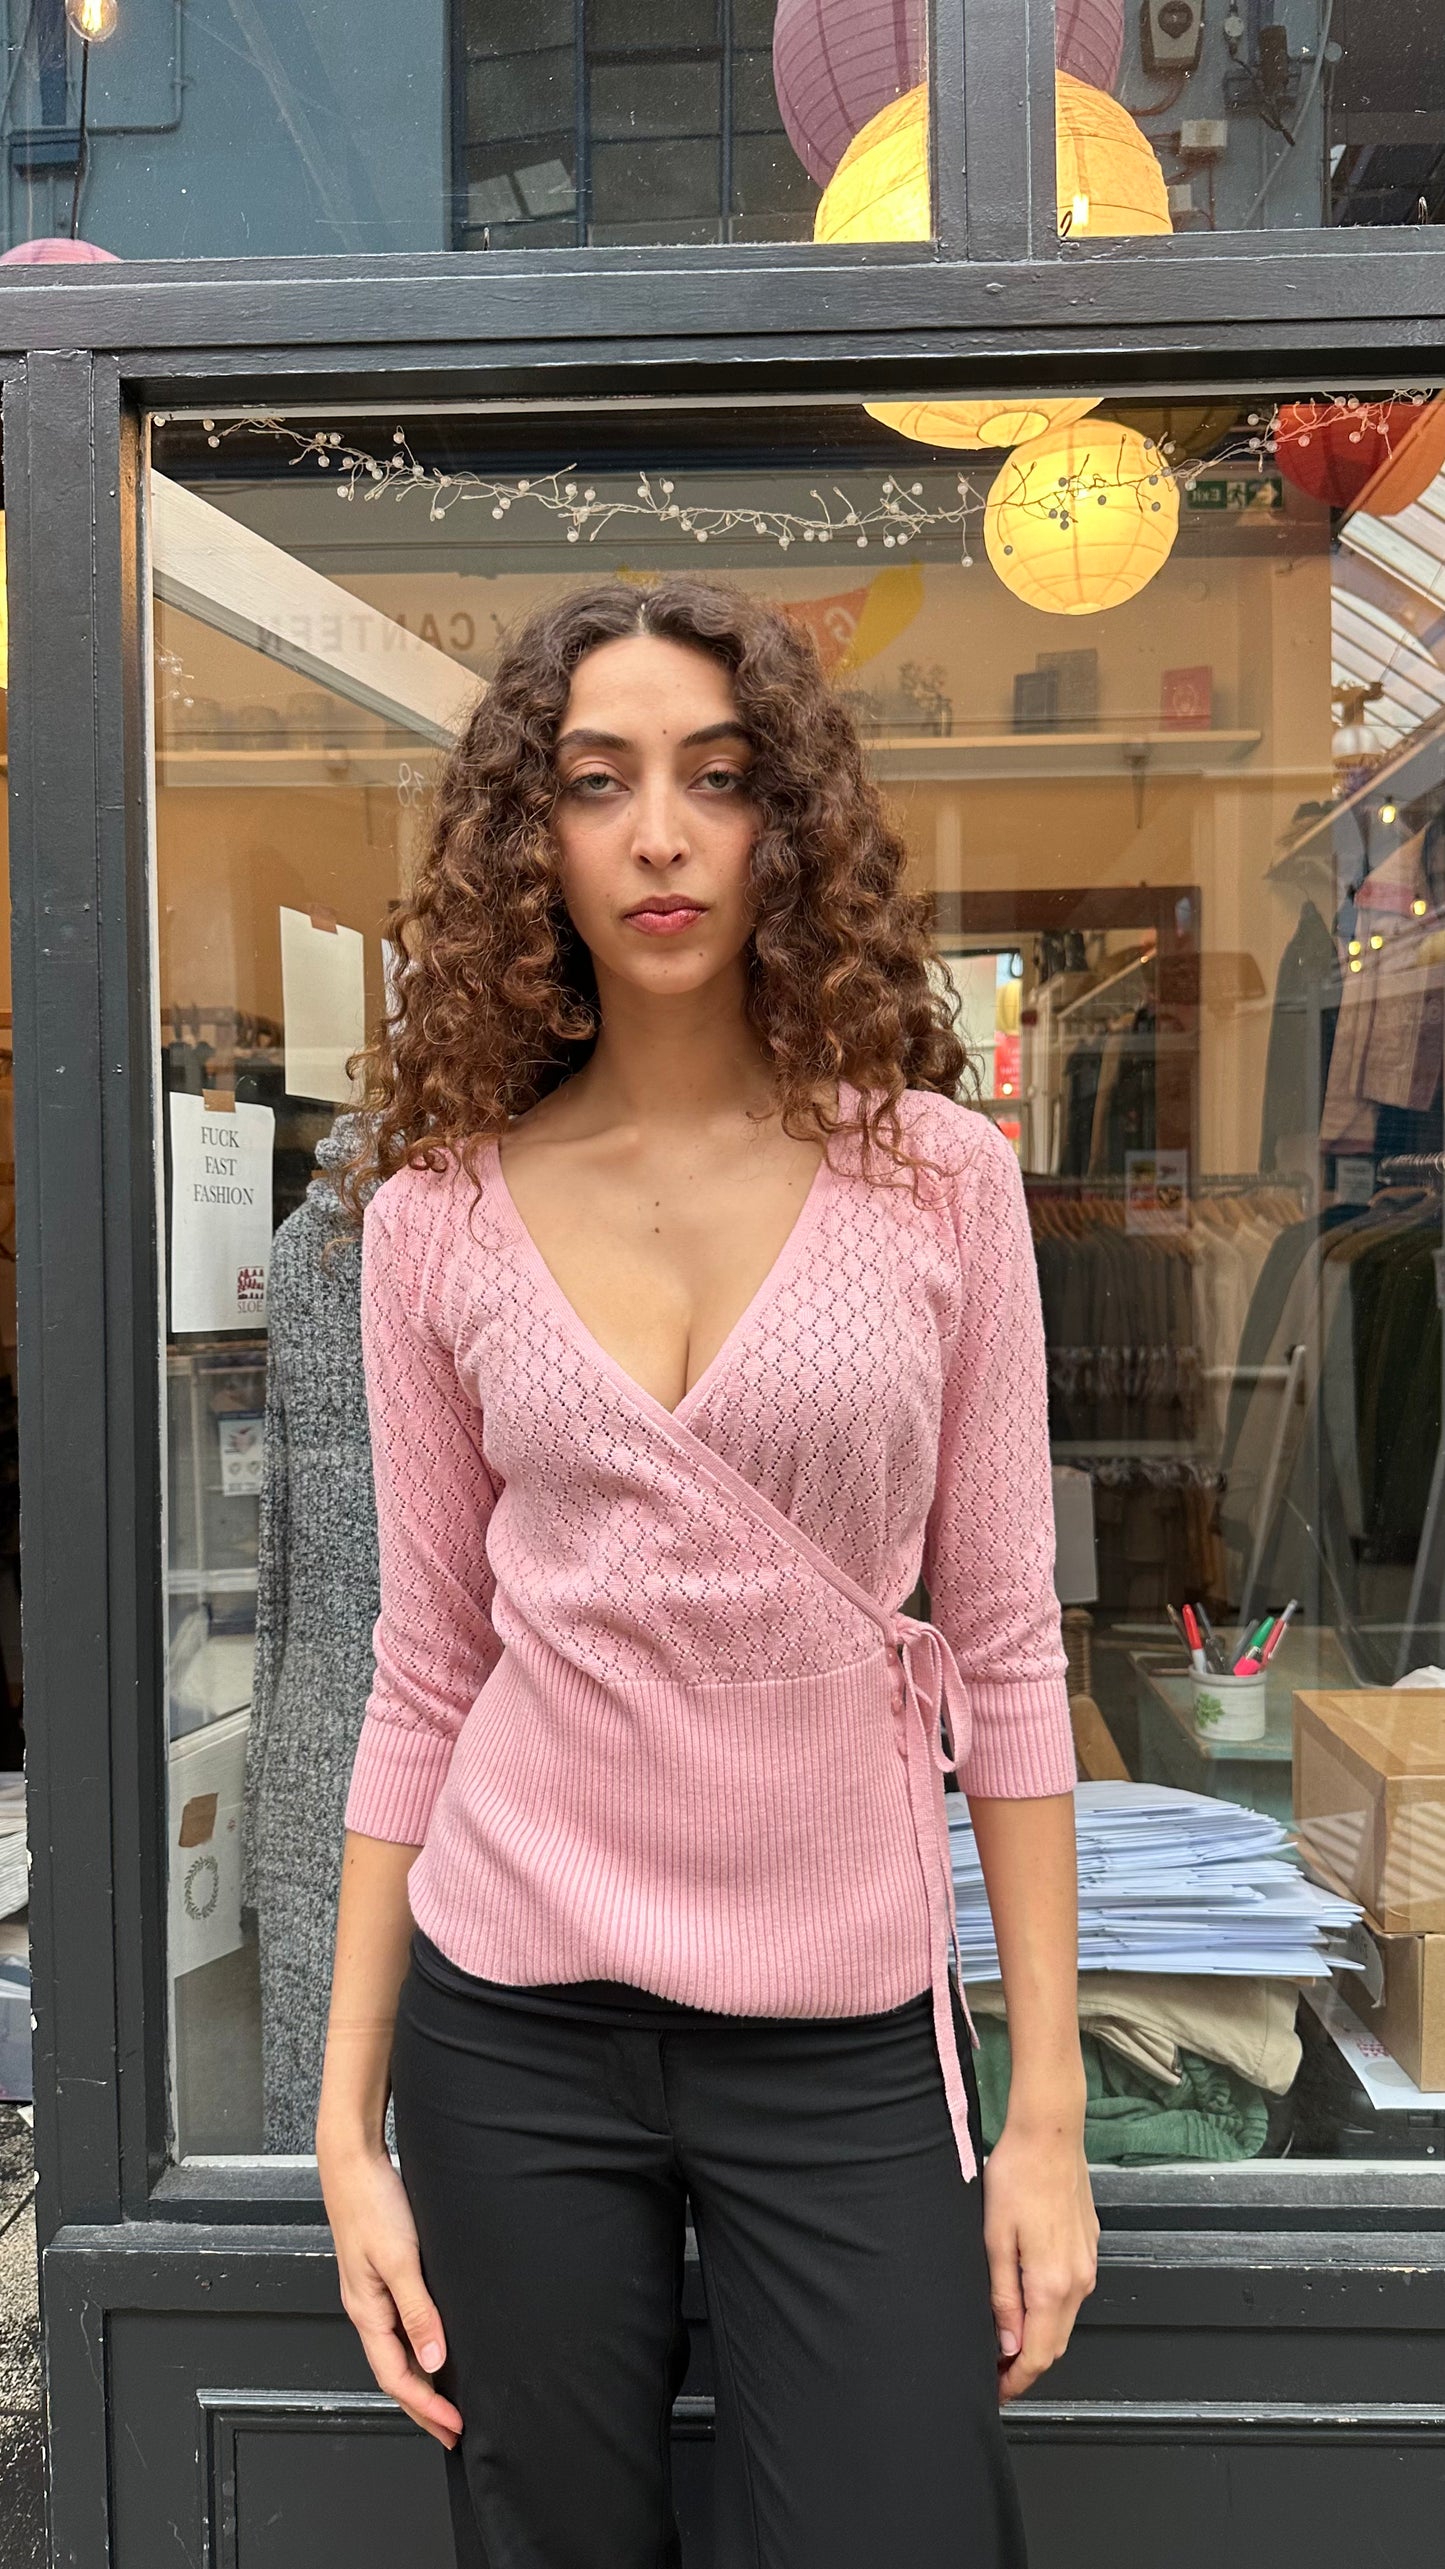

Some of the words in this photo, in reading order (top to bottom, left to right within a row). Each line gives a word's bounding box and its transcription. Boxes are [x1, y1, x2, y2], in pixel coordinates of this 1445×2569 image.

[201, 1126, 240, 1148] FUCK
[205, 1155, 237, 1176] FAST
[193, 1183, 254, 1206] FASHION
